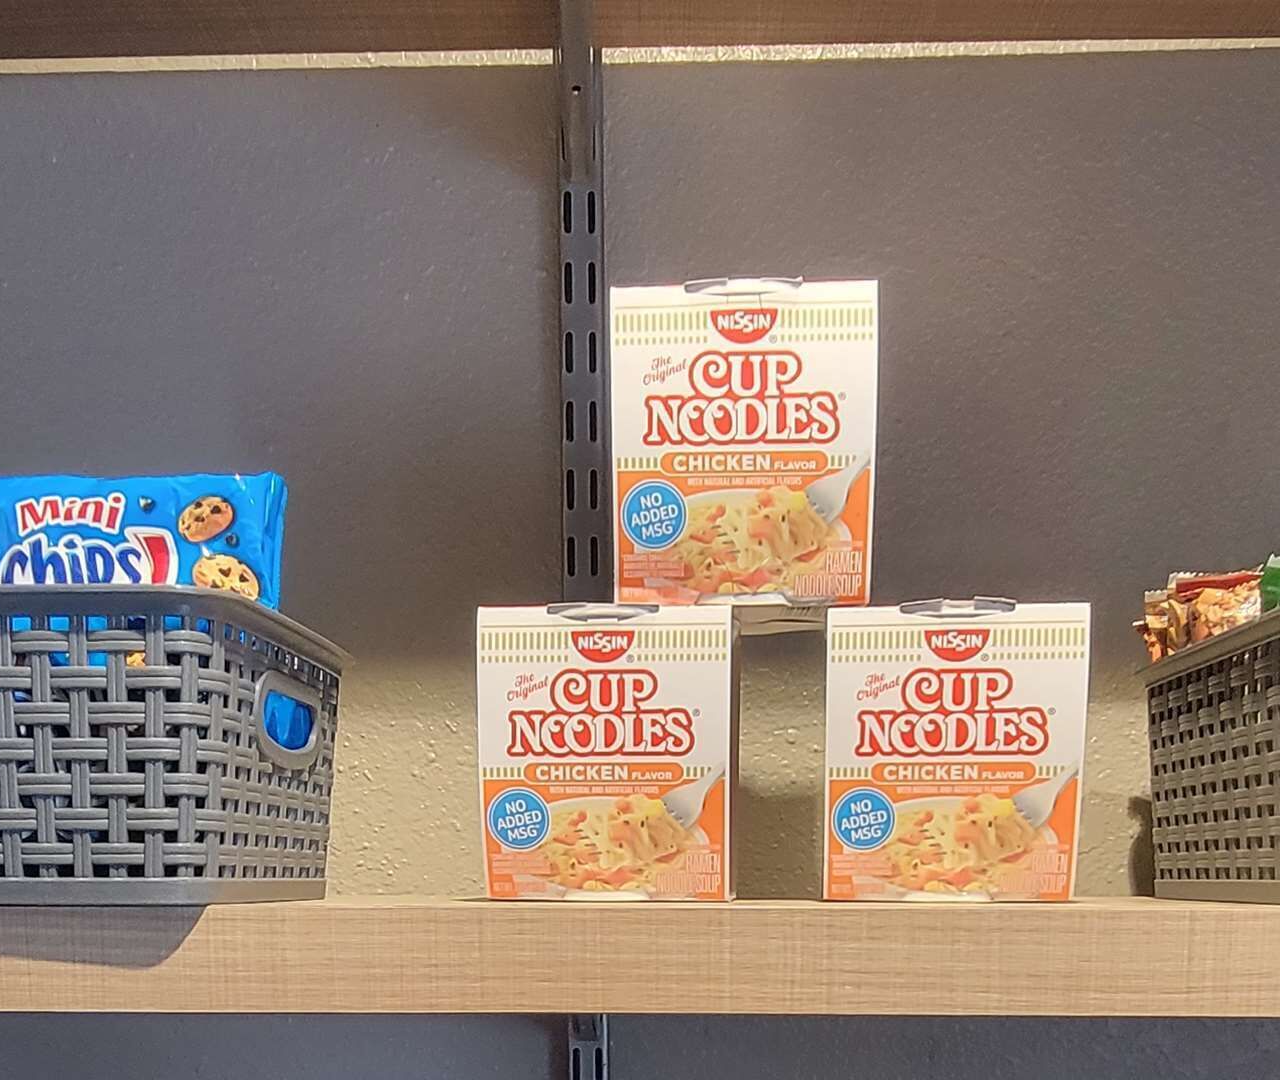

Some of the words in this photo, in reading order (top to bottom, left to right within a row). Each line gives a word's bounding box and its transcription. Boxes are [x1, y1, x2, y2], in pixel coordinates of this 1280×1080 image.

[717, 311, 771, 333] NISSIN
[643, 359, 687, 386] Original
[651, 355, 672, 371] The
[690, 352, 800, 397] CUP
[645, 393, 838, 443] NOODLES
[673, 455, 770, 472] CHICKEN
[774, 460, 816, 471] FLAVOR
[639, 492, 662, 510] NO
[20, 496, 123, 531] Mini
[631, 504, 679, 528] ADDED
[641, 522, 674, 540] MSG
[826, 551, 863, 574] RAMEN
[836, 574, 862, 597] SOUP
[578, 632, 628, 652] NISSIN
[931, 631, 984, 652] NISSIN
[506, 676, 548, 702] Original
[515, 672, 535, 686] The
[856, 676, 901, 701] Original
[865, 672, 885, 686] The
[552, 671, 656, 712] CUP
[903, 670, 1010, 711] CUP
[509, 710, 692, 754] NOODLES
[857, 709, 1046, 754] NOODLES
[535, 765, 628, 781] CHICKEN
[632, 771, 673, 781] FLAVOR
[883, 765, 978, 781] CHICKEN
[982, 771, 1024, 780] FLAVOR
[505, 799, 526, 814] NO
[850, 799, 872, 814] NO
[497, 811, 542, 831] ADDED
[840, 811, 887, 831] ADDED
[507, 826, 538, 842] MSG
[850, 825, 882, 842] MSG
